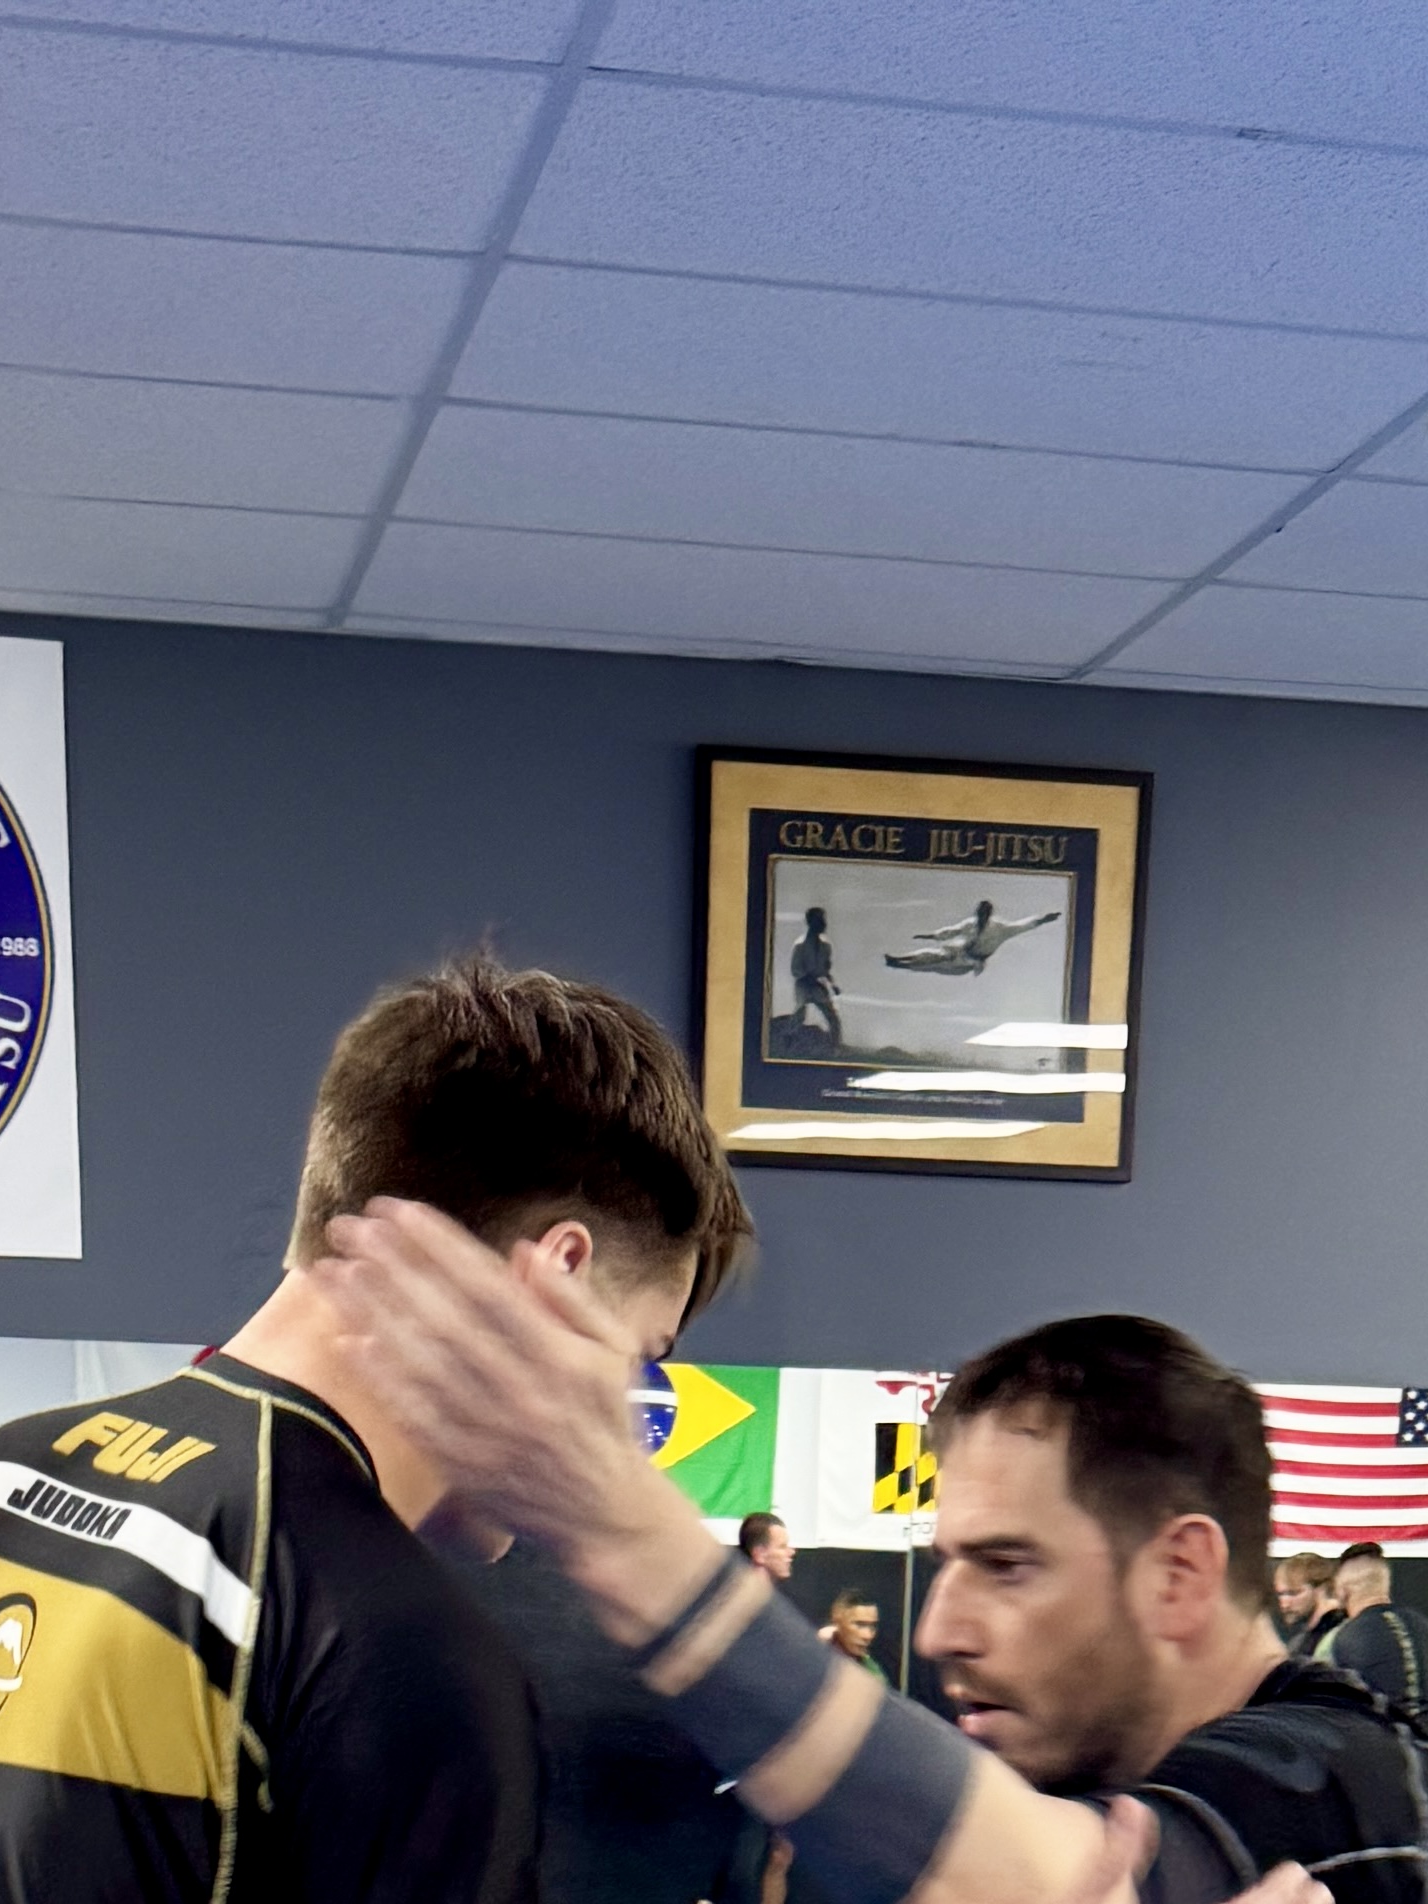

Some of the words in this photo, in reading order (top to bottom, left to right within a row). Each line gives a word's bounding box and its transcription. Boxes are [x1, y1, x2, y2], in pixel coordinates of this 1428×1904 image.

[779, 820, 906, 855] GRACIE
[930, 829, 1071, 866] JIU-JITSU
[52, 1412, 217, 1482] FUJI
[7, 1480, 132, 1541] JUDOKA
